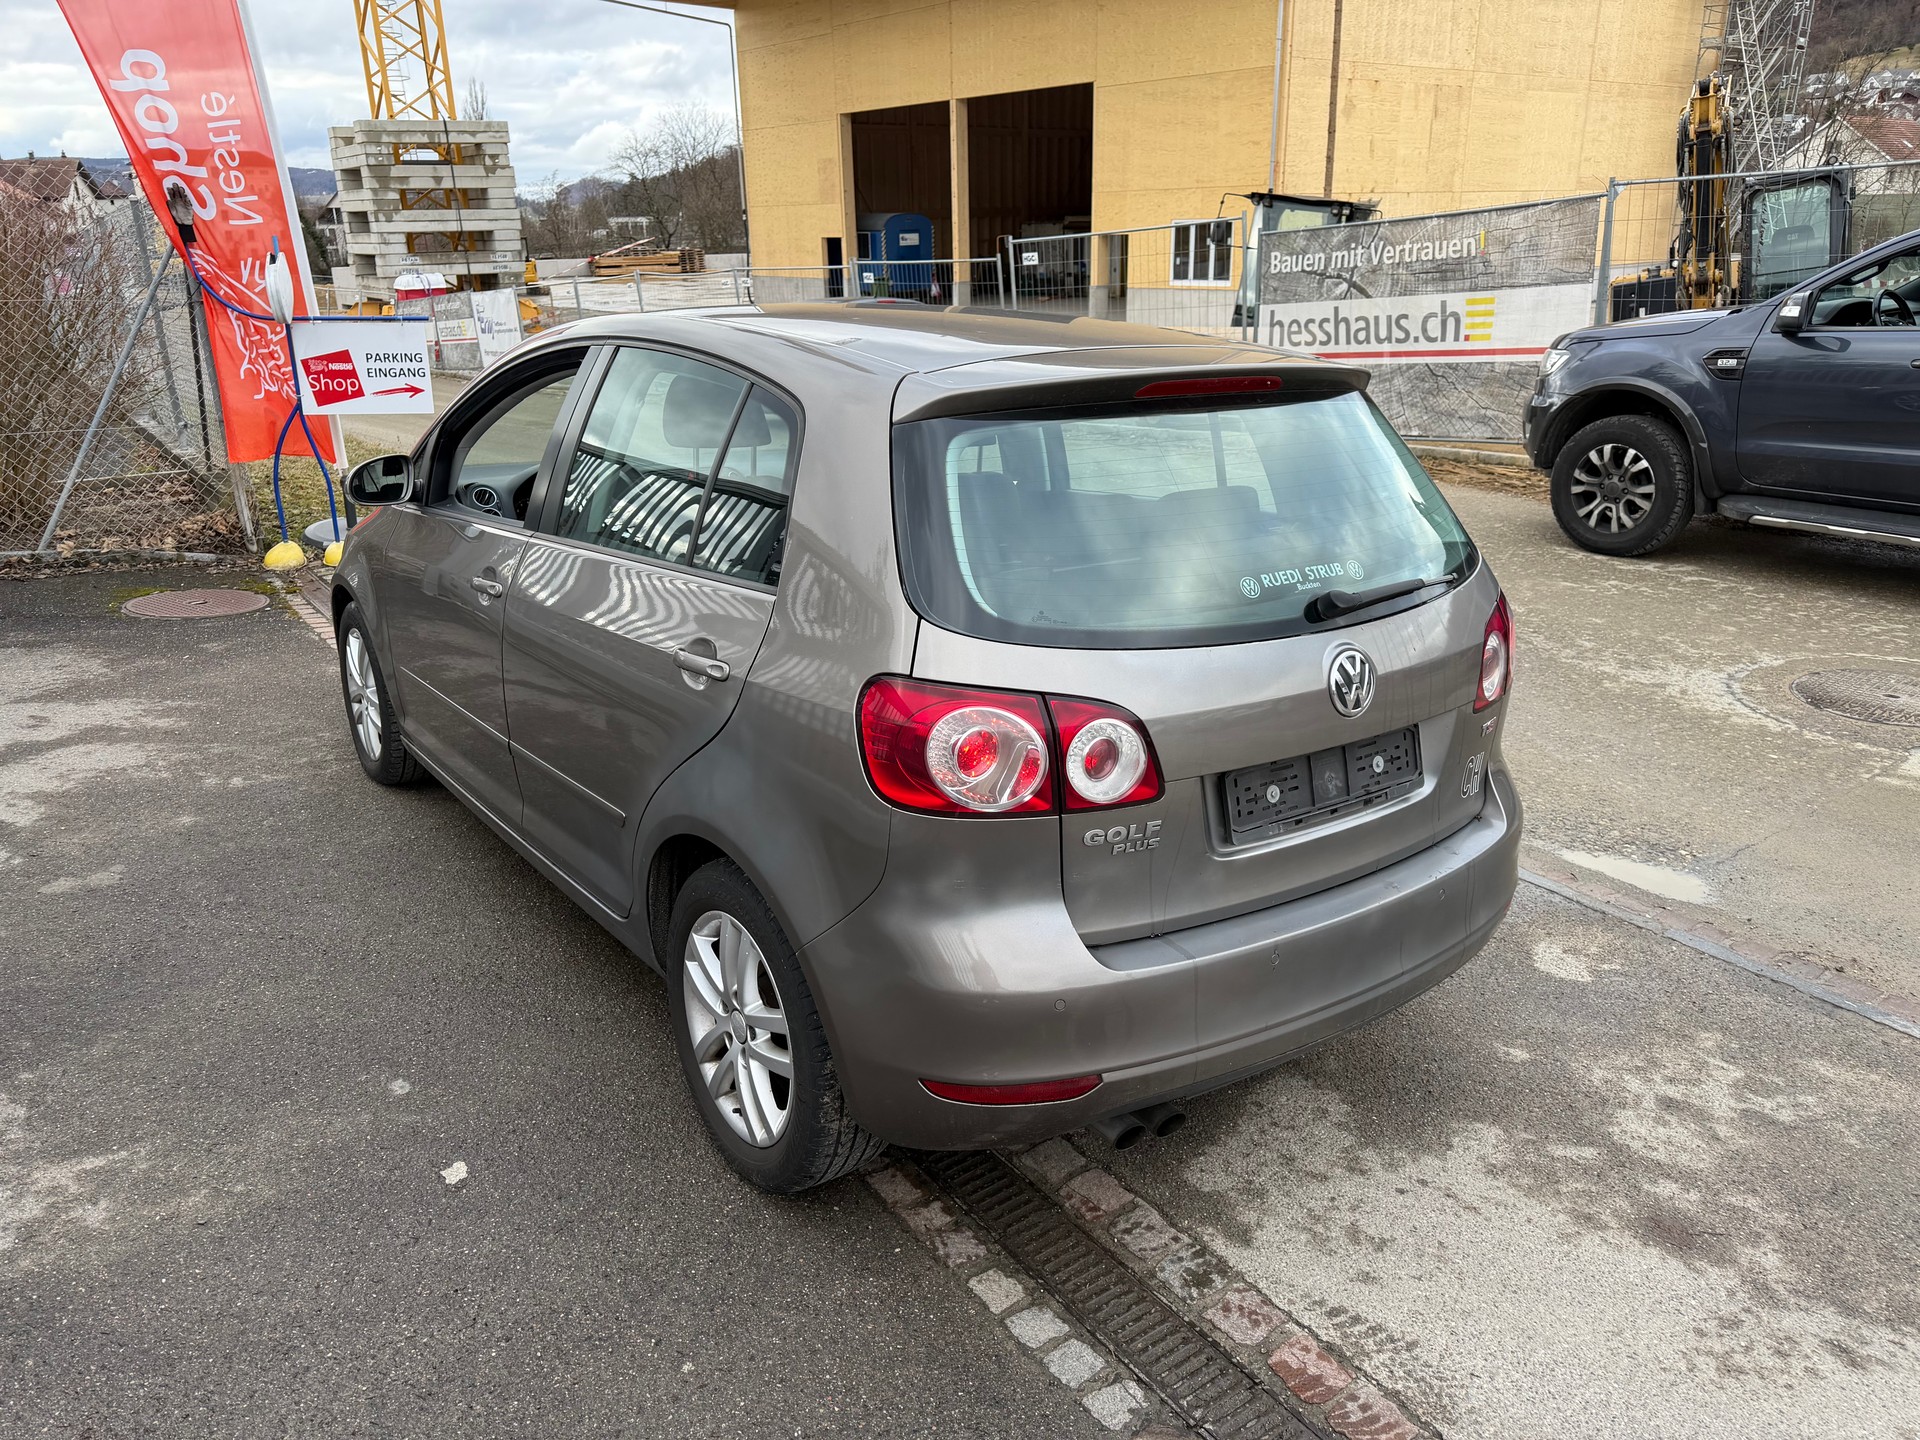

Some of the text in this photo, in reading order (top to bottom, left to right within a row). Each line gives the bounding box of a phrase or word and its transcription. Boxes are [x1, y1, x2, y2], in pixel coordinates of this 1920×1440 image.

[1270, 229, 1486, 274] Bauen mit Vertrauen!
[1269, 300, 1461, 347] hesshaus.ch
[365, 352, 423, 363] PARKING
[367, 367, 426, 378] EINGANG
[308, 374, 359, 395] Shop
[1260, 563, 1344, 588] RUEDI STRUB
[1296, 581, 1322, 591] Buckten
[1461, 751, 1485, 798] CH
[1083, 820, 1162, 847] GOLF
[1111, 837, 1161, 856] PLUS
